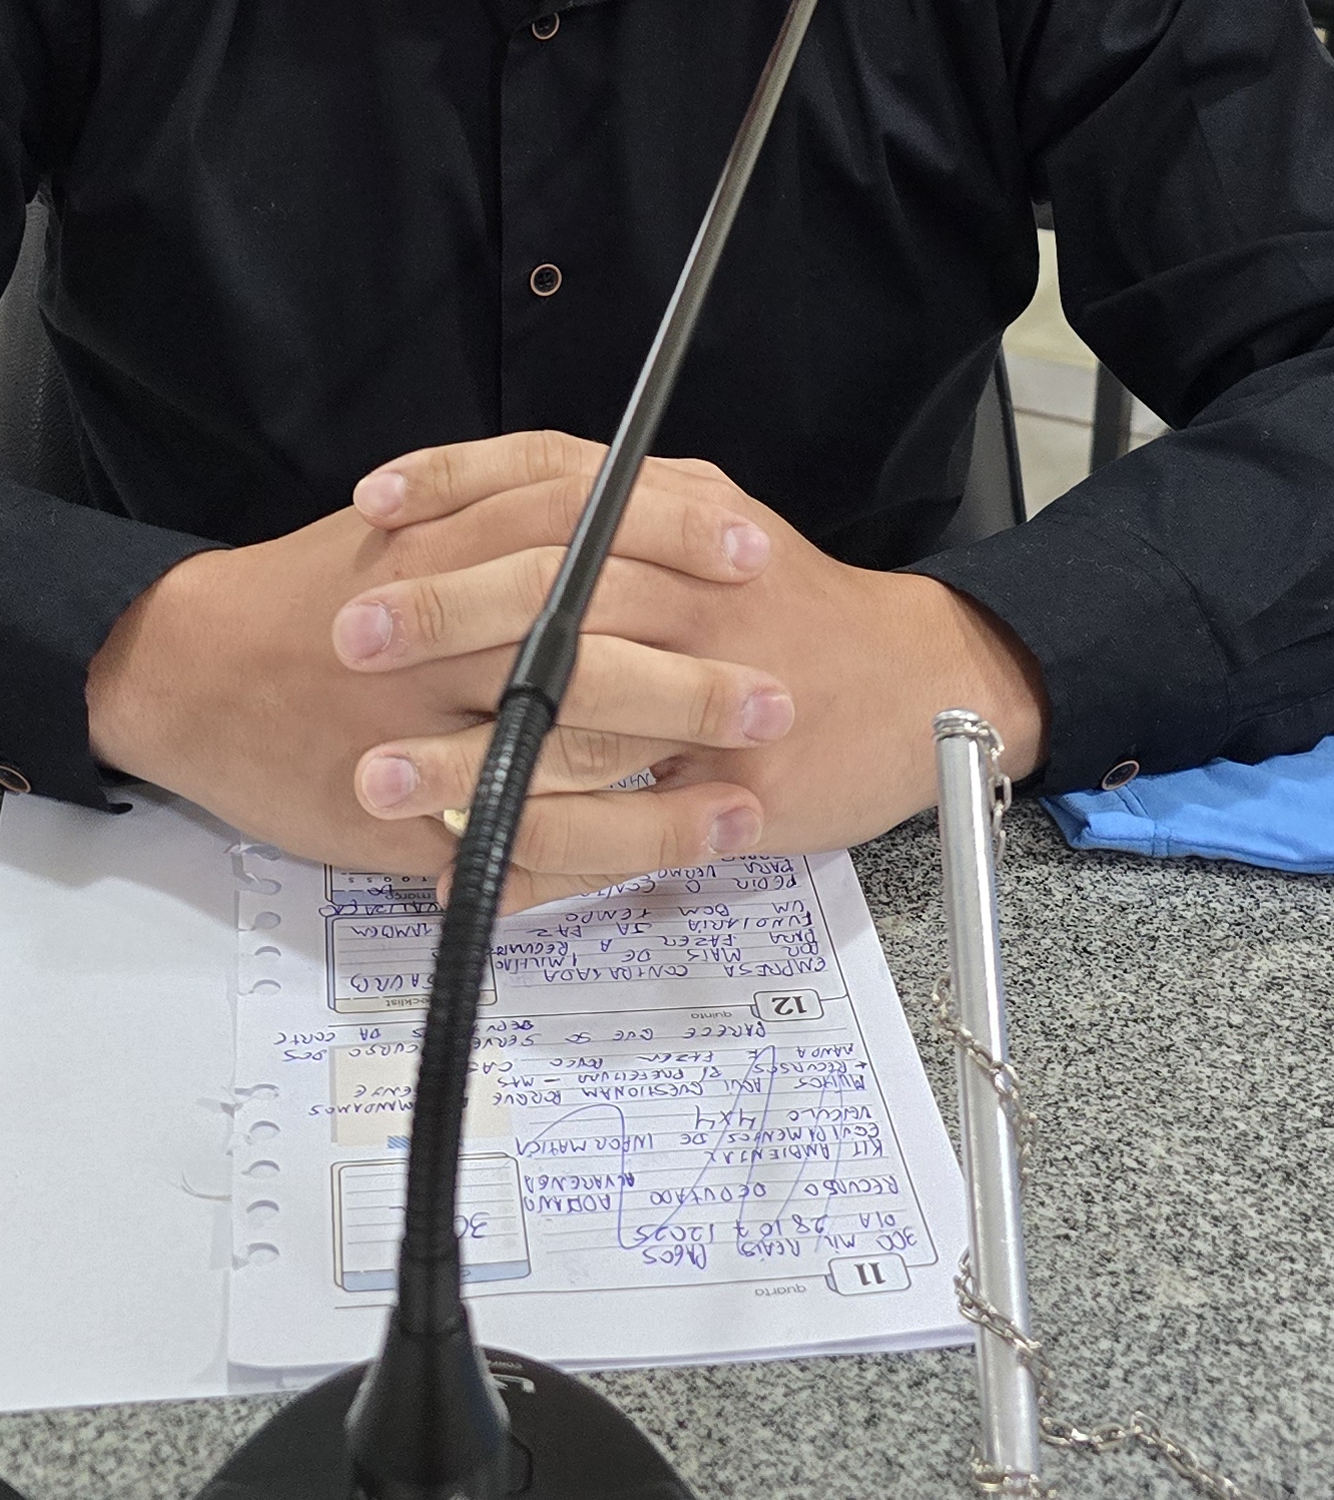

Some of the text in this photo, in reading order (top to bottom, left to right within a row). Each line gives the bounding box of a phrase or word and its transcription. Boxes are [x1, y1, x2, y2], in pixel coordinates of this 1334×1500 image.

[744, 859, 793, 874] PARA
[732, 874, 797, 892] PEDIR
[564, 900, 804, 923] UM BOM TEMPO
[769, 928, 815, 944] PARA
[601, 939, 612, 952] A
[781, 941, 819, 957] POR
[621, 949, 650, 963] DE
[686, 947, 741, 962] MAIS
[723, 957, 826, 978] EMPRESA
[385, 998, 429, 1007] ecklist
[771, 995, 807, 1015] 12
[691, 1011, 732, 1019] quinta
[359, 1027, 380, 1041] DA
[613, 1027, 653, 1042] QUE
[683, 1022, 765, 1039] PARECE
[493, 1090, 561, 1106] PORQUE
[582, 1081, 703, 1101] QUESTIONAM
[680, 1133, 707, 1145] DE
[852, 1138, 883, 1157] KIT
[524, 1172, 635, 1193] ALVARENGA
[805, 1175, 899, 1196] RECURSO
[650, 1181, 766, 1205] DEPUTADO
[859, 1211, 895, 1232] DIA
[876, 1226, 917, 1251] 300
[642, 1244, 707, 1270] PAGOS
[854, 1262, 886, 1286] 11
[755, 1284, 806, 1296] quarta
